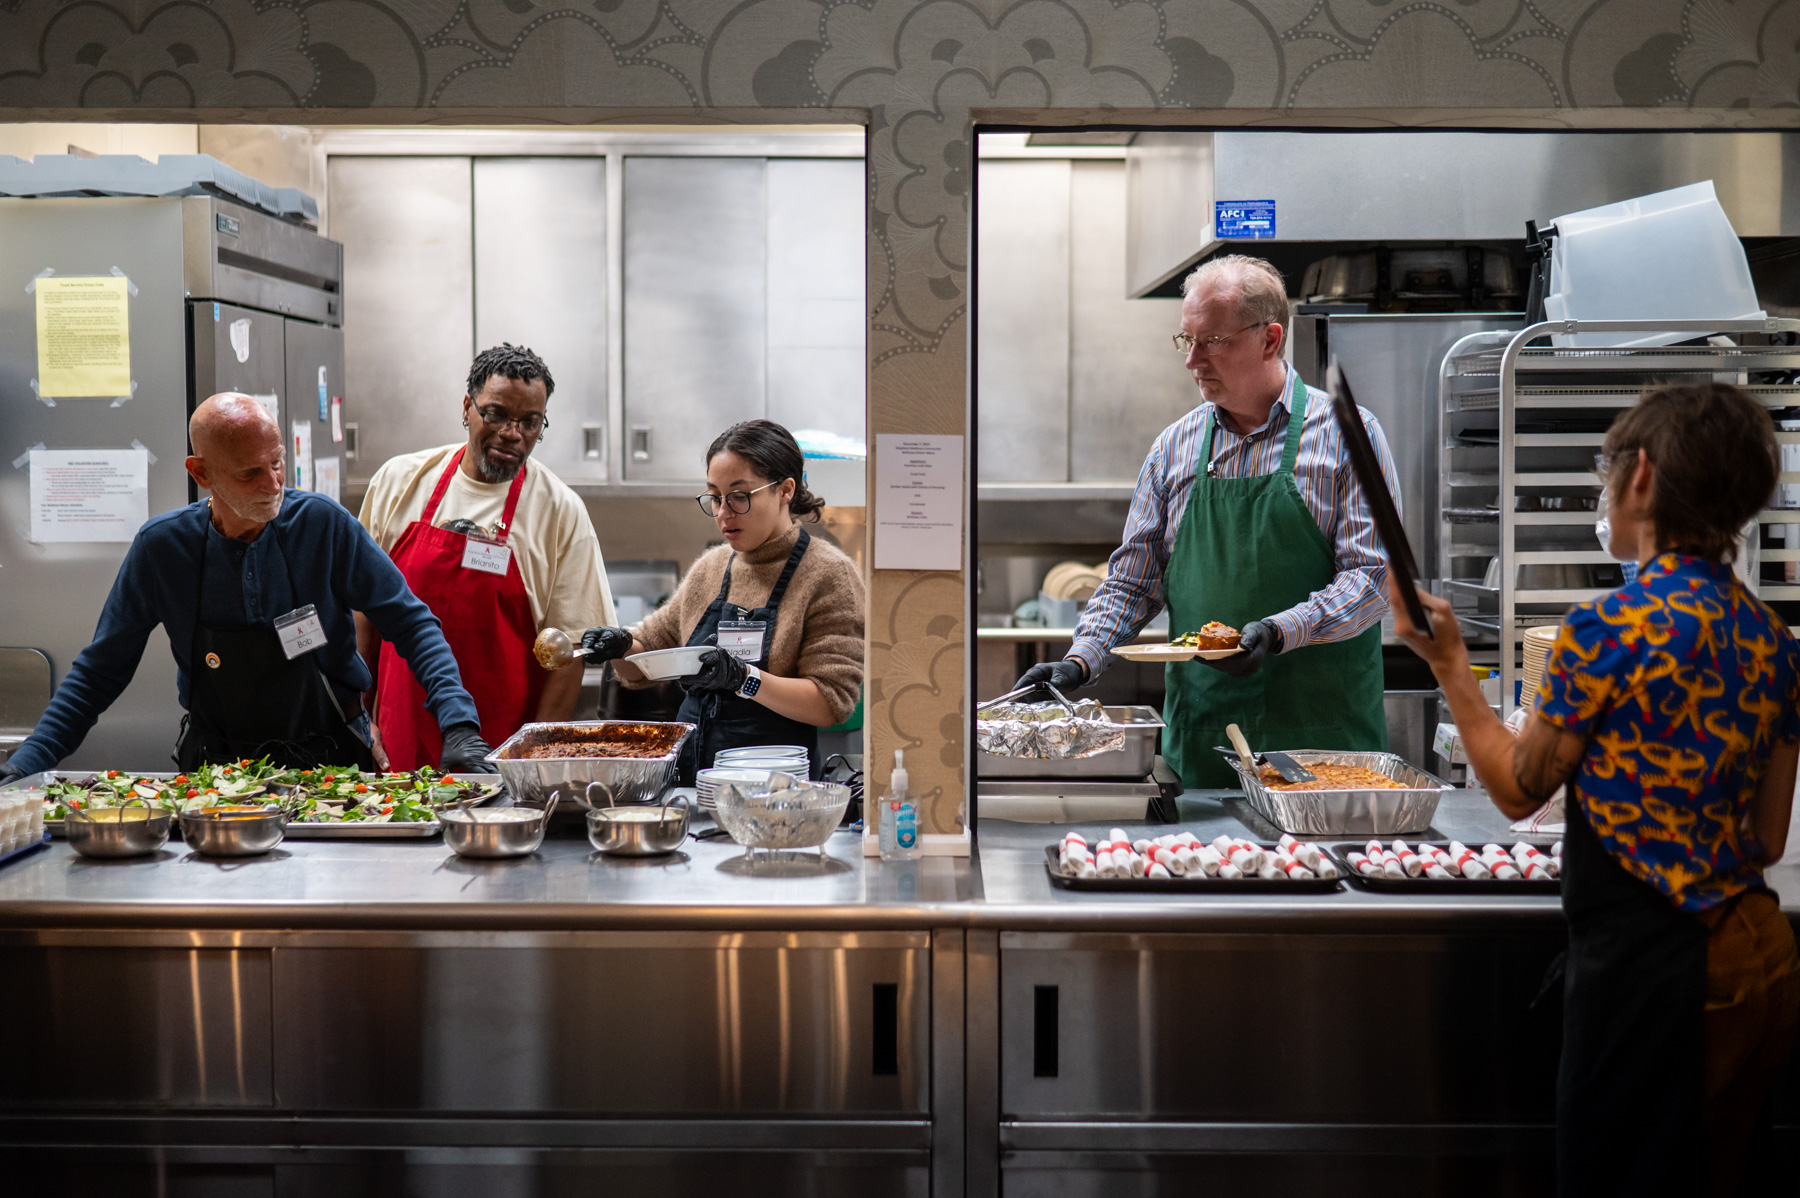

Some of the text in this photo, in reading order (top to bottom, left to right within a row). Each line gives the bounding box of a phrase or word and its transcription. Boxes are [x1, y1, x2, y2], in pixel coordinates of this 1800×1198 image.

[470, 557, 500, 569] Brianito
[297, 638, 313, 649] Bob
[726, 648, 751, 656] Nadia
